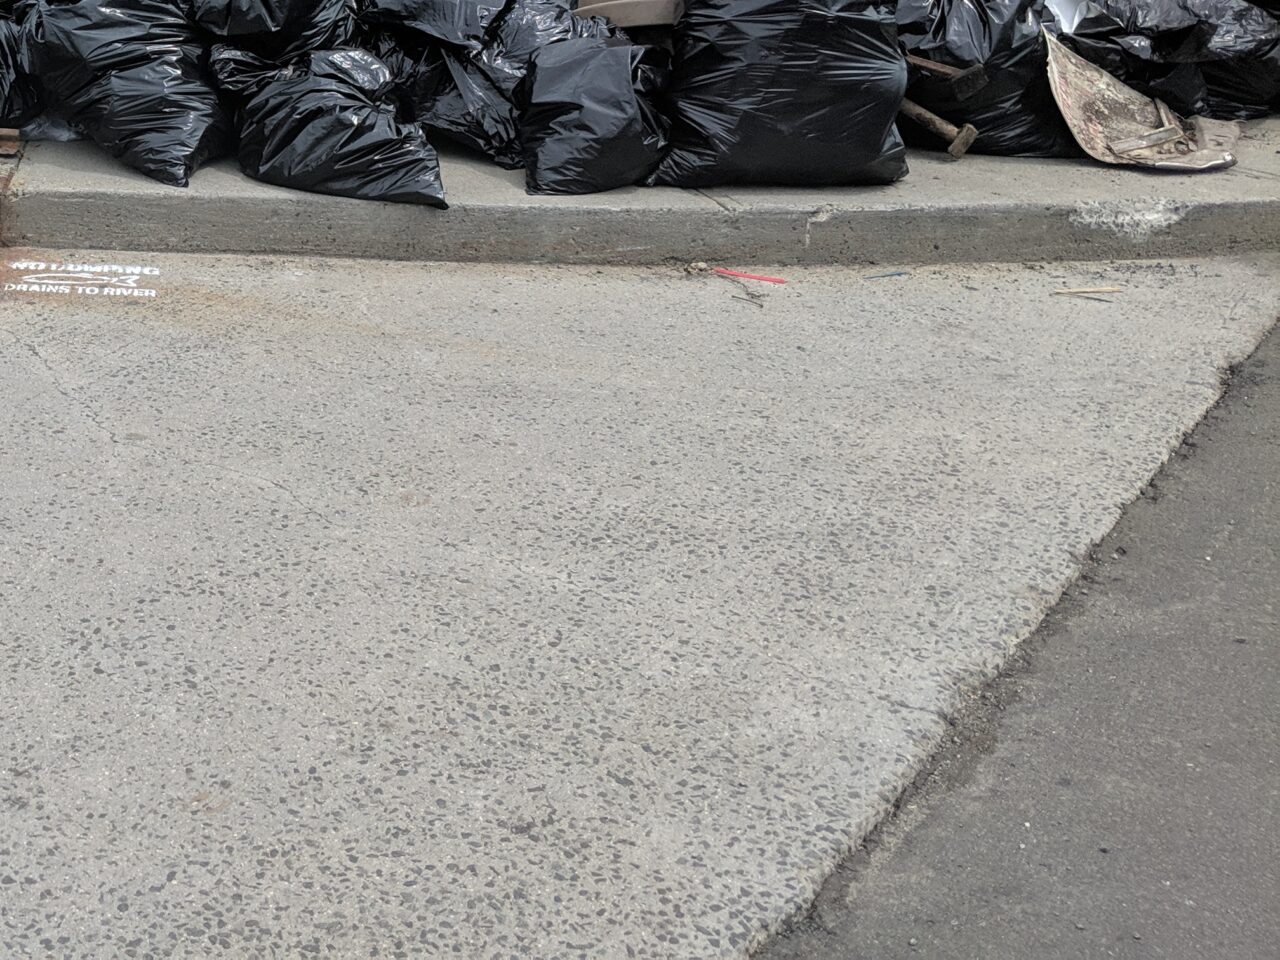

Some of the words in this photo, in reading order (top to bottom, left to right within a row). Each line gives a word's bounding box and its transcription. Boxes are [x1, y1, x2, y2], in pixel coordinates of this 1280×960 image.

[4, 283, 70, 294] DRAINS
[77, 286, 99, 295] TO
[103, 287, 156, 297] RIVER
